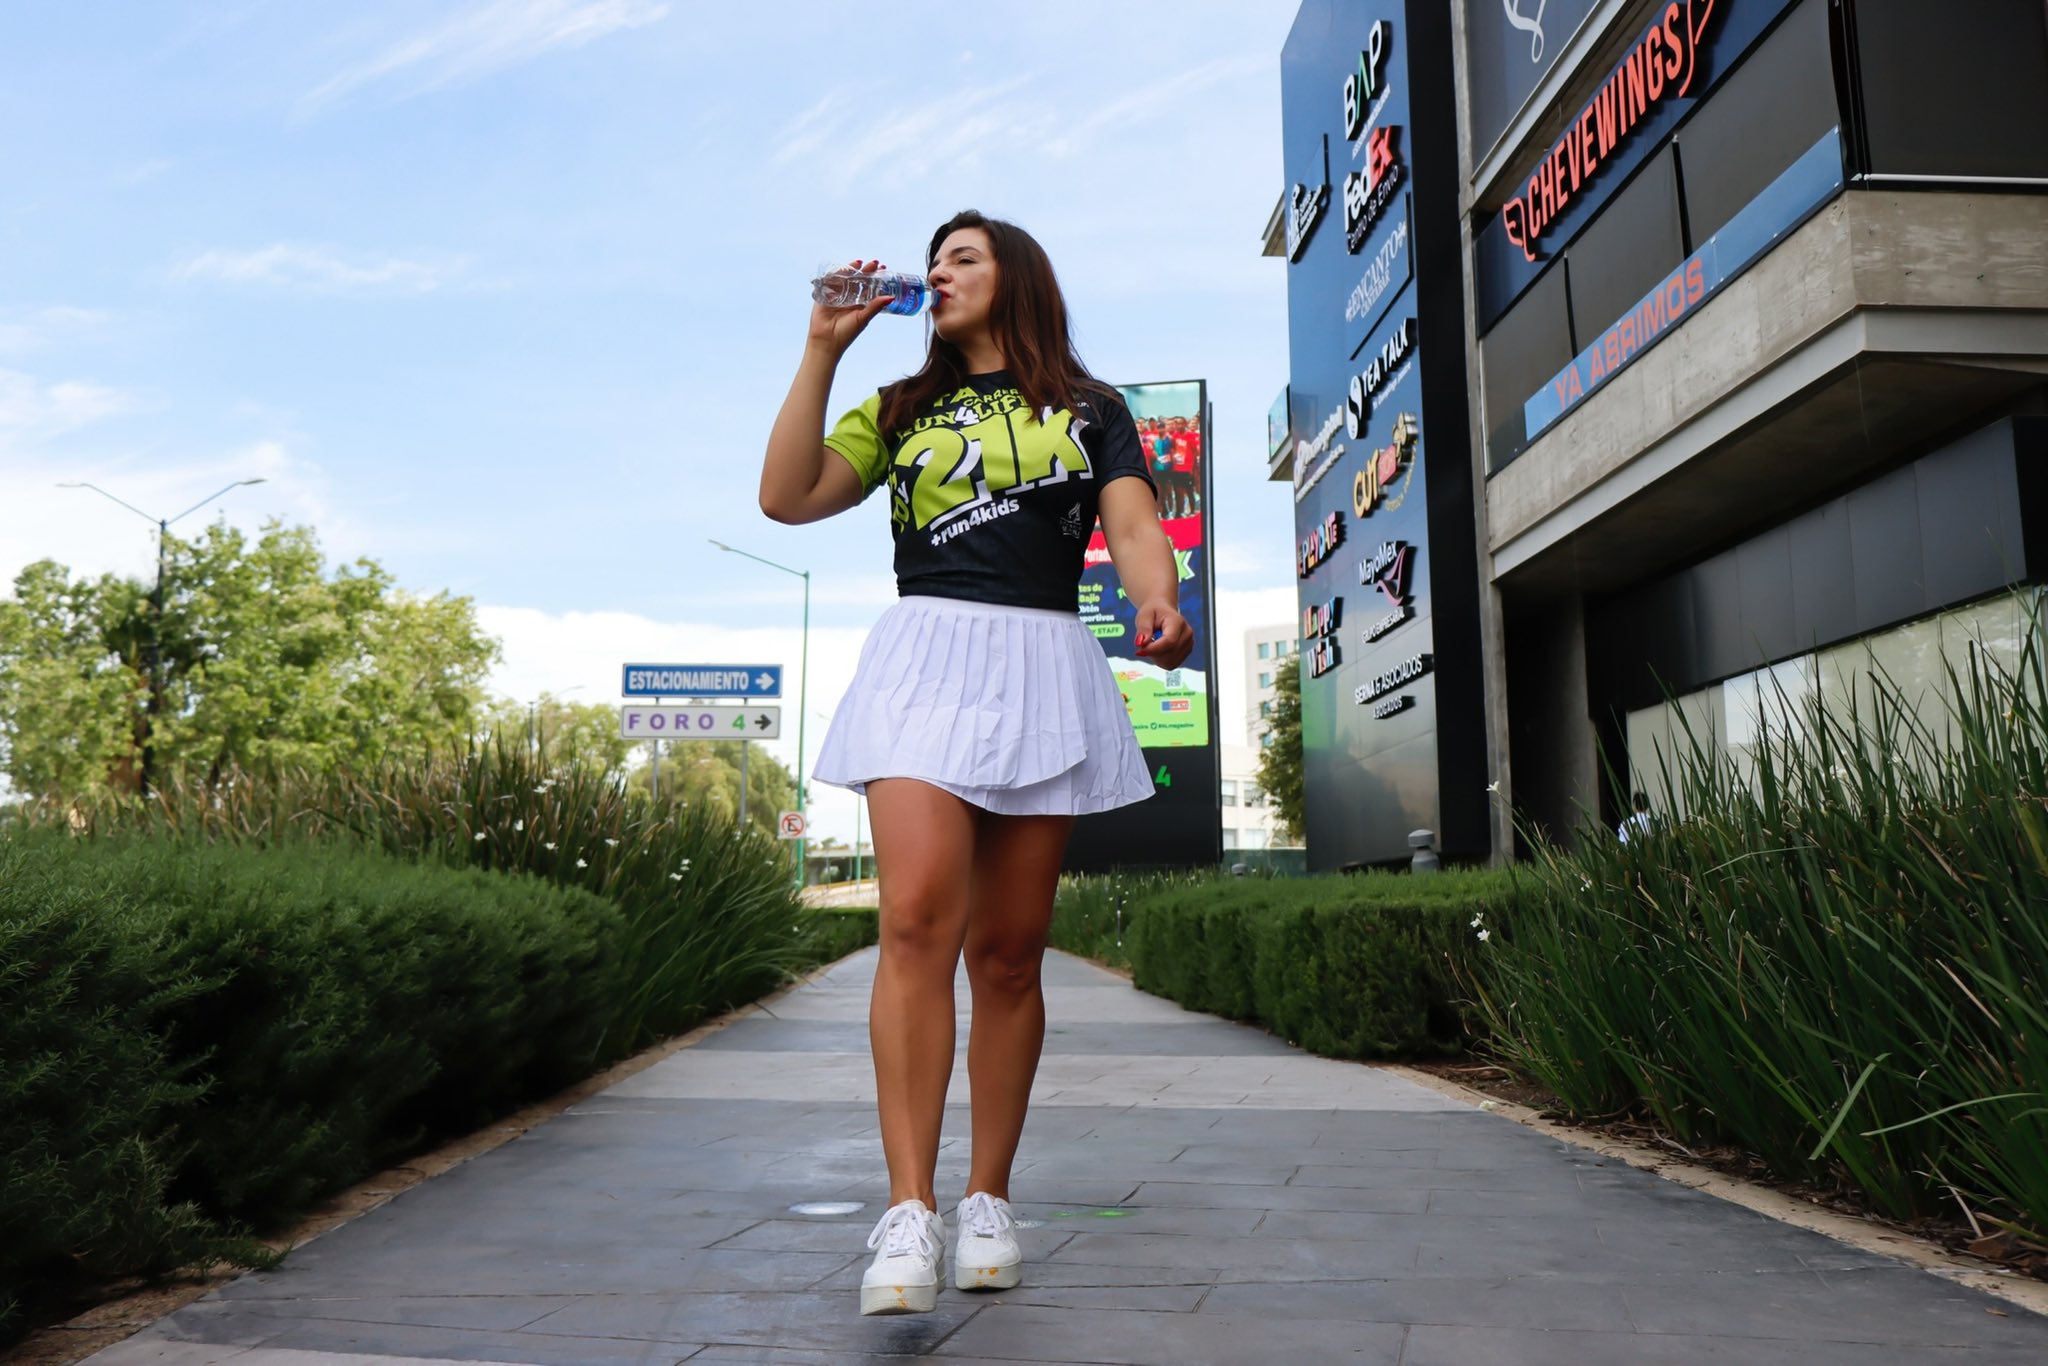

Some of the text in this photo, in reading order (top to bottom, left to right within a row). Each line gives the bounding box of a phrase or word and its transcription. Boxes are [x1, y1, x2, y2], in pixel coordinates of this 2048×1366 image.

[1527, 2, 1682, 239] CHEVEWINGS
[1343, 123, 1394, 234] FedEx
[1361, 356, 1382, 398] TEA
[1381, 317, 1409, 373] TALK
[1555, 257, 1705, 411] YA ABRIMOS
[963, 387, 1020, 407] CARRER
[895, 405, 1094, 531] 21K
[931, 498, 1020, 547] +run4kids
[1359, 541, 1397, 586] MayoMex
[628, 671, 749, 691] ESTACIONAMIENTO
[1381, 653, 1424, 691] ASOCIADOS
[628, 713, 746, 731] FORO 4
[1373, 696, 1403, 719] ABOGADOS
